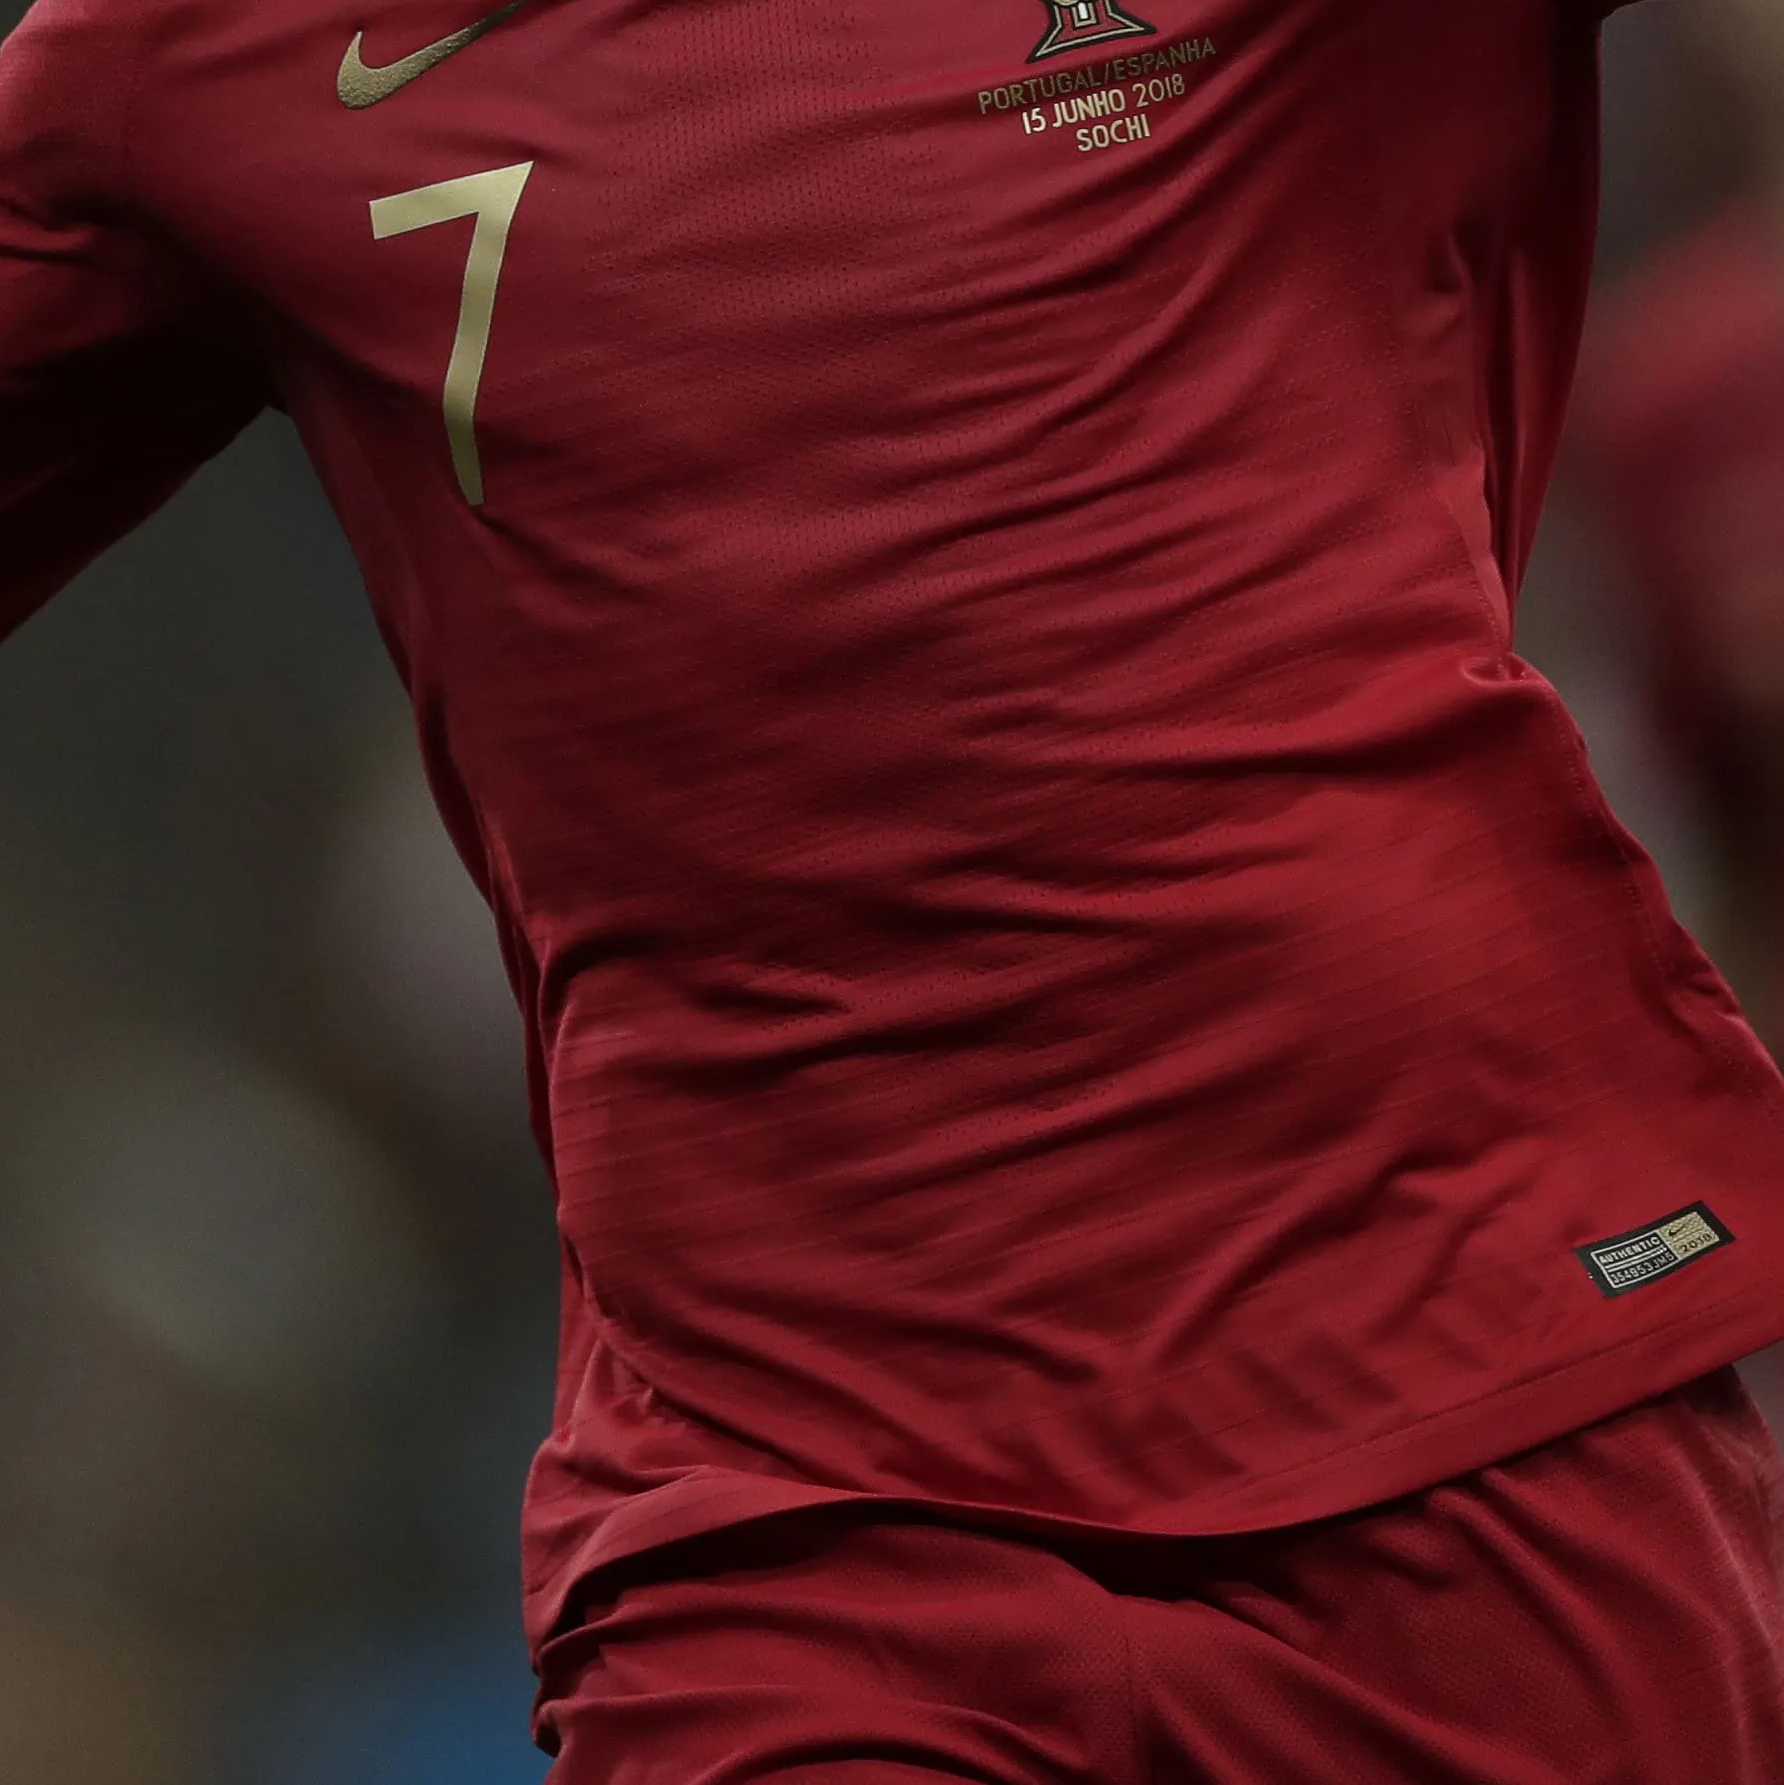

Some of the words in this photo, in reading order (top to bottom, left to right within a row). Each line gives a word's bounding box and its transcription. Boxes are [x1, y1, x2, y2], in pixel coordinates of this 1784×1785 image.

[977, 37, 1216, 115] PORTUGAL/ESPANHA
[1021, 107, 1047, 135] 15
[1052, 89, 1126, 128] JUNHO
[1132, 73, 1186, 108] 2018
[1076, 113, 1151, 152] SOCHI
[369, 160, 534, 506] 7
[1598, 1236, 1661, 1264] AUTHENTIC
